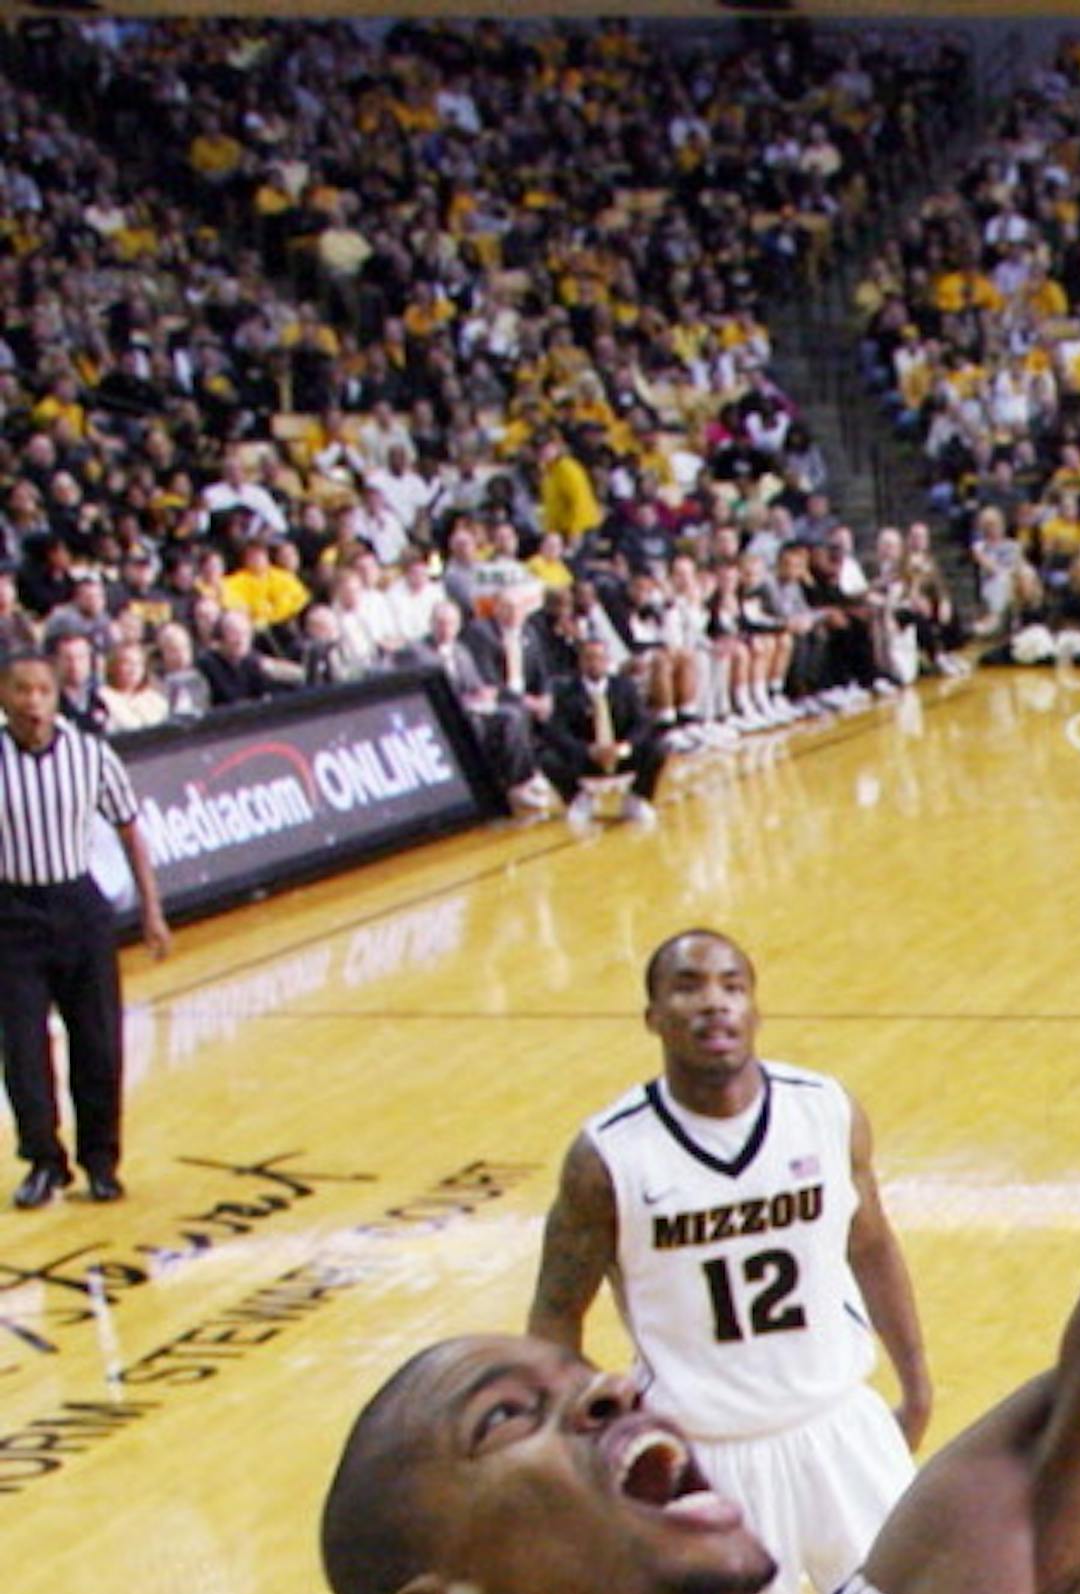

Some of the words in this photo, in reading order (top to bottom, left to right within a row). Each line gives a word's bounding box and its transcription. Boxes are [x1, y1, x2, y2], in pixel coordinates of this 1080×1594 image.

[137, 781, 315, 868] Mediacom
[313, 722, 451, 812] ONLINE
[653, 1183, 825, 1252] MIZZOU
[702, 1247, 808, 1344] 12
